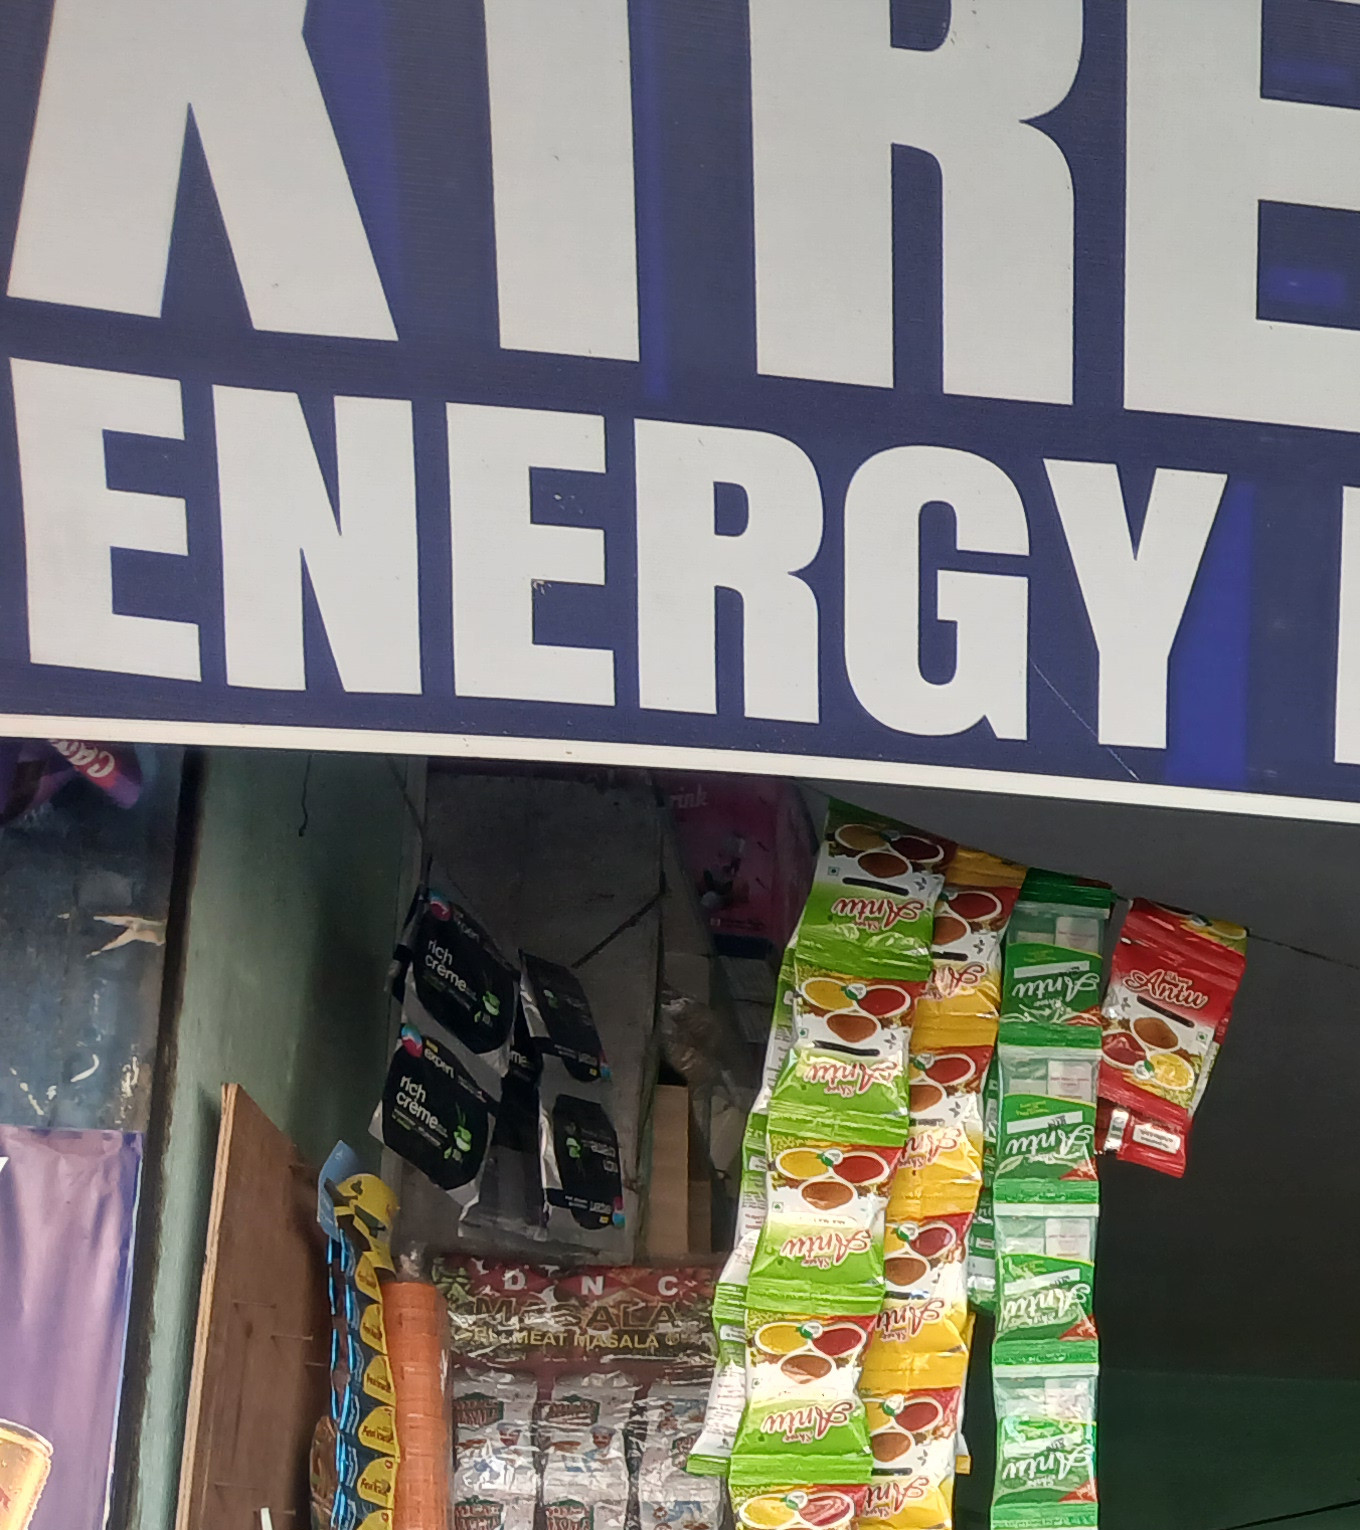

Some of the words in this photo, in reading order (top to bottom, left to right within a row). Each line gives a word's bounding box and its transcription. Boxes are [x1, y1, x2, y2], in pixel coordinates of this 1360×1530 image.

[8, 356, 1228, 749] ENERGY
[832, 895, 926, 923] Antu
[1123, 970, 1210, 1010] Antu
[400, 1074, 428, 1104] rich
[781, 1227, 874, 1264] Antu
[574, 1331, 660, 1349] MASALA
[760, 1400, 854, 1436] Antu
